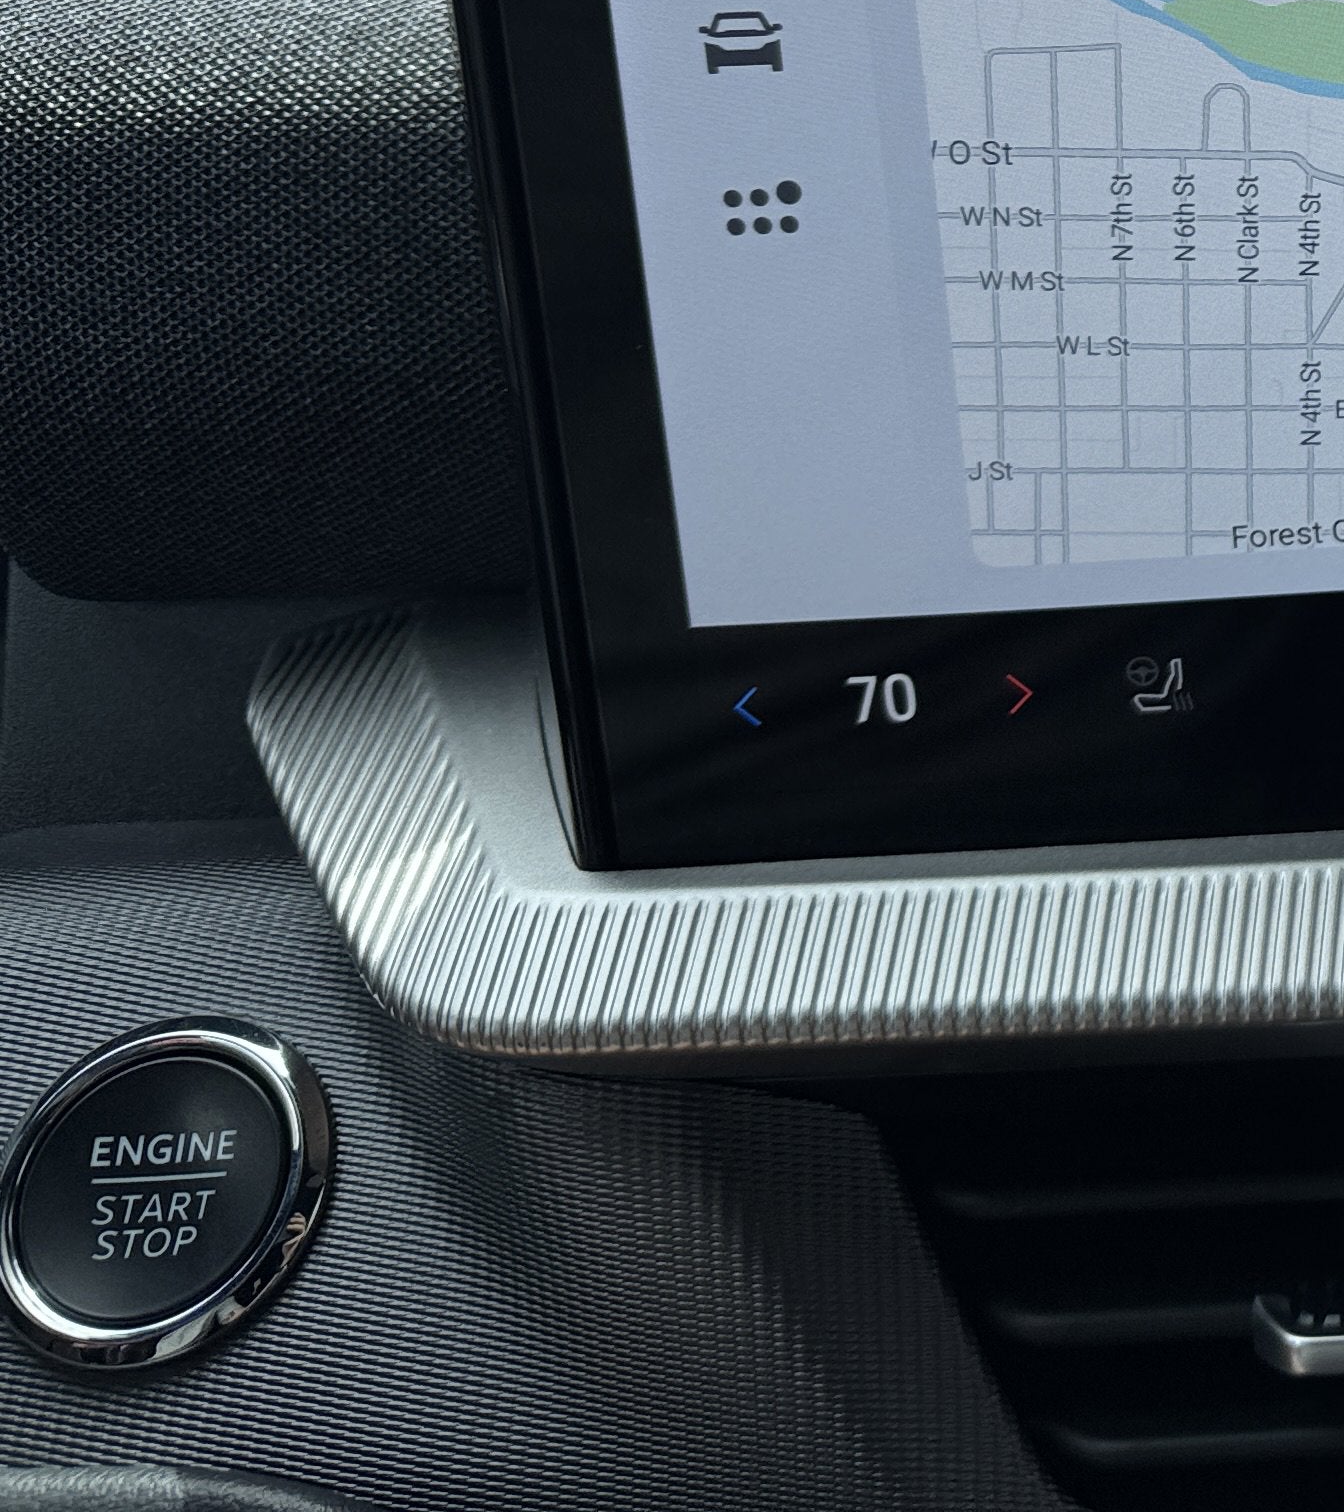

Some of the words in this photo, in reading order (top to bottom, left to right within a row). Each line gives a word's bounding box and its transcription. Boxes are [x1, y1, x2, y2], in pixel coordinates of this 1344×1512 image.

[949, 139, 971, 165] O
[981, 140, 1014, 166] St
[1109, 173, 1133, 196] St
[1172, 173, 1196, 197] St
[1236, 175, 1260, 198] St
[1298, 192, 1322, 215] St
[959, 205, 986, 227] W
[992, 206, 1011, 227] N
[1018, 206, 1044, 228] St
[1109, 202, 1134, 238] 7th
[1172, 203, 1196, 238] 6th
[1236, 204, 1260, 260] Clark
[1298, 219, 1321, 255] 4th
[1111, 245, 1134, 261] N
[1173, 245, 1196, 261] N
[1237, 267, 1260, 283] N
[1298, 260, 1321, 276] N
[978, 270, 1004, 291] W
[1010, 270, 1034, 291] M
[1040, 270, 1066, 292] St
[1056, 335, 1080, 355] W
[1087, 335, 1101, 356] L
[1107, 335, 1131, 357] St
[1299, 360, 1322, 383] St
[1299, 388, 1322, 423] 4th
[1300, 430, 1322, 446] N
[967, 461, 982, 481] J
[988, 460, 1014, 481] St
[1231, 522, 1324, 549] Forest
[845, 672, 918, 724] 70
[89, 1128, 238, 1168] ENGINE
[90, 1188, 217, 1226] START
[90, 1225, 199, 1261] STOP
